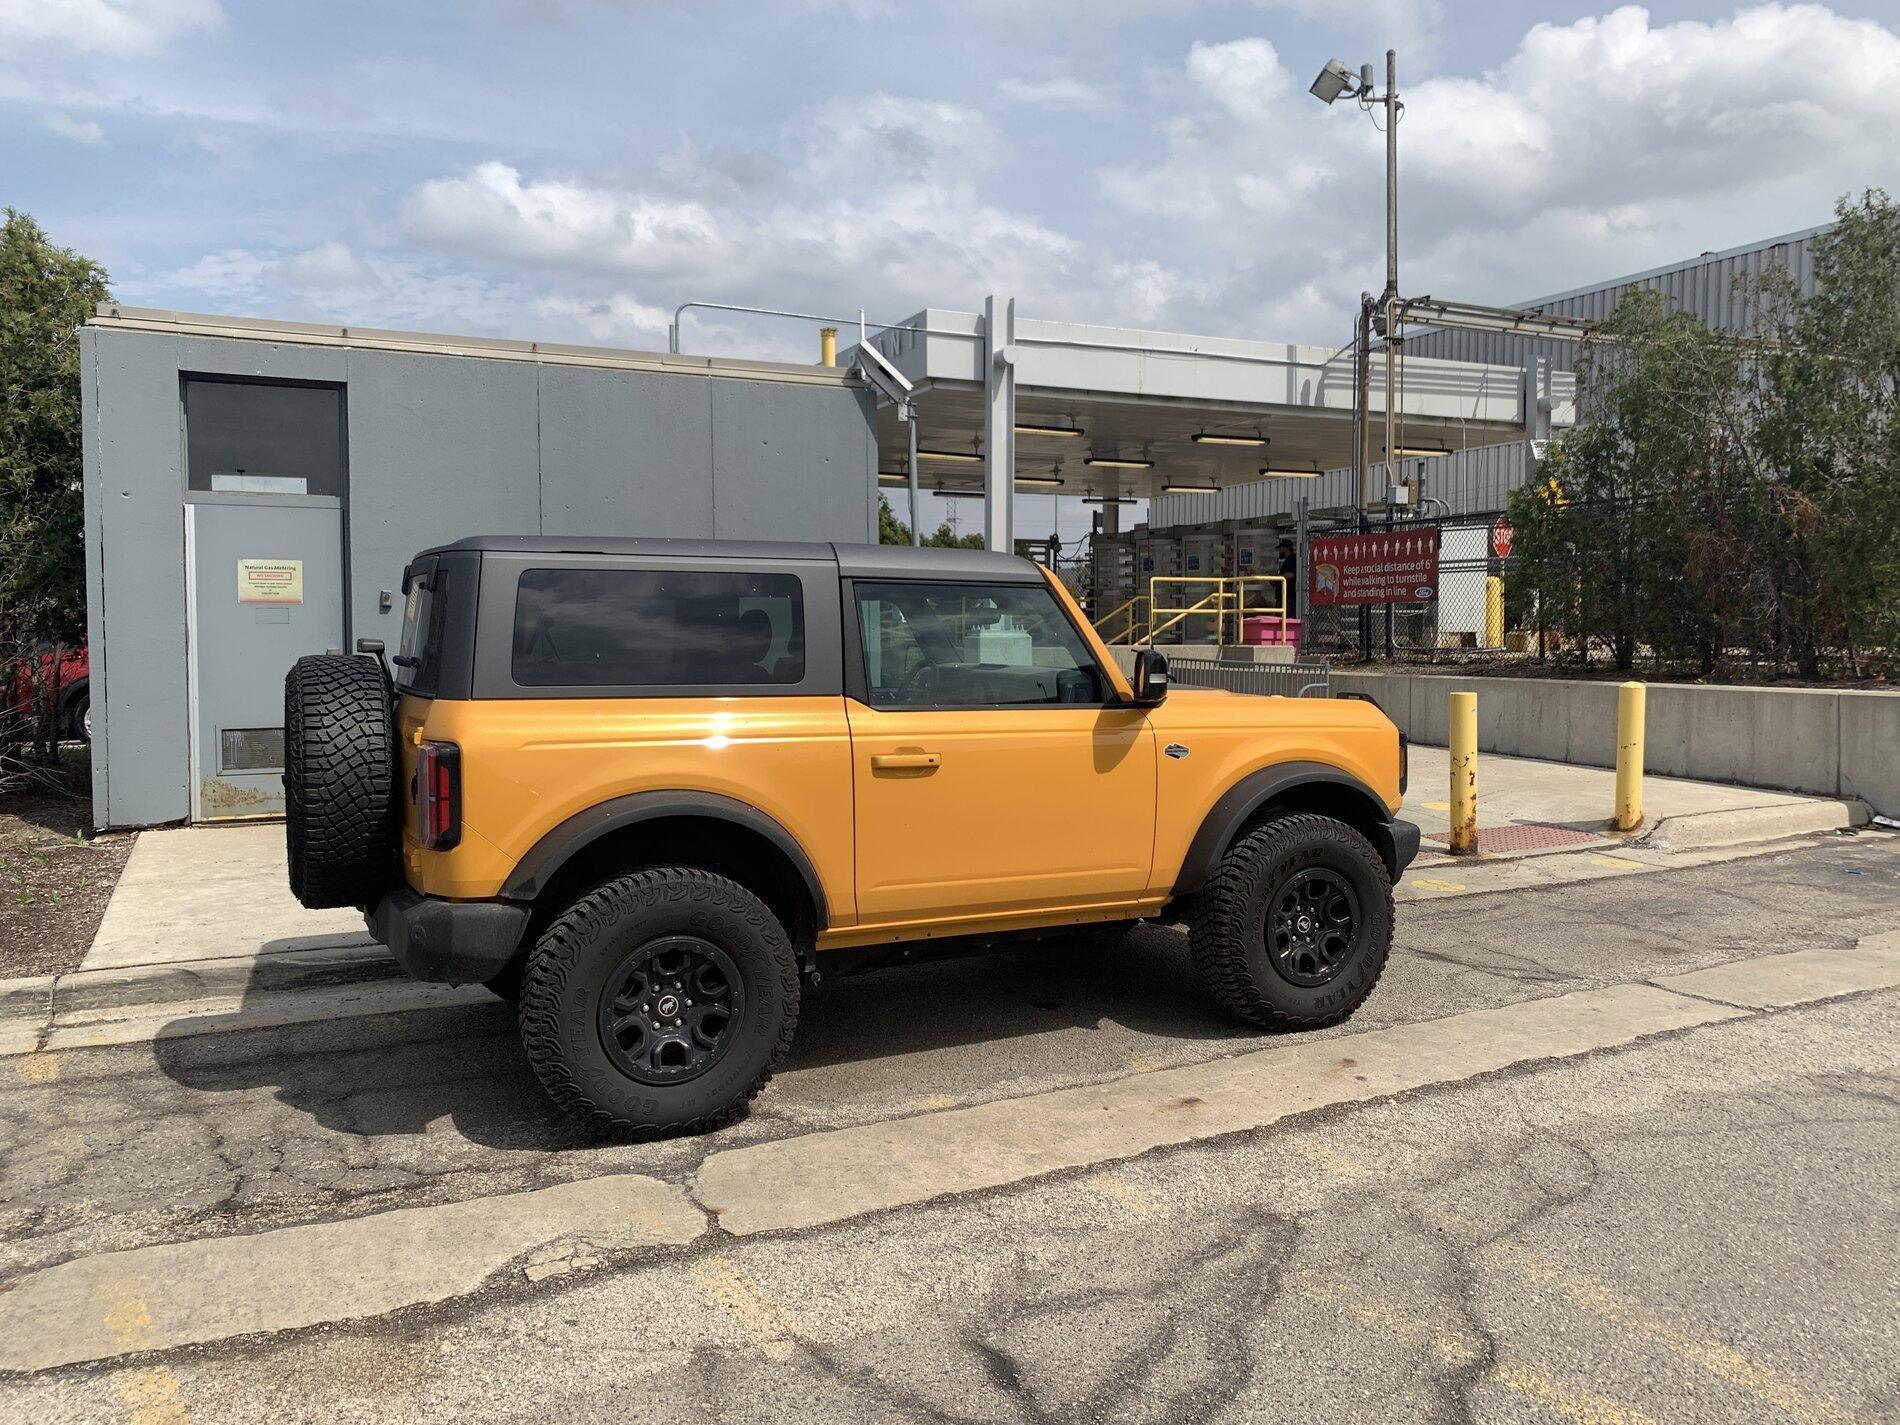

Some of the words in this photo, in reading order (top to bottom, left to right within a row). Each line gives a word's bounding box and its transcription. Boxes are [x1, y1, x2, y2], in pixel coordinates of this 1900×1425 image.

[1495, 527, 1514, 545] STOP
[1343, 565, 1360, 575] Keep
[1364, 563, 1383, 574] social
[1384, 561, 1415, 572] distance
[1416, 560, 1424, 570] of
[1387, 574, 1395, 584] to
[1395, 572, 1427, 584] turnstile
[1343, 588, 1357, 598] and
[1357, 587, 1385, 599] standing
[1385, 586, 1393, 596] in
[1393, 586, 1407, 596] line
